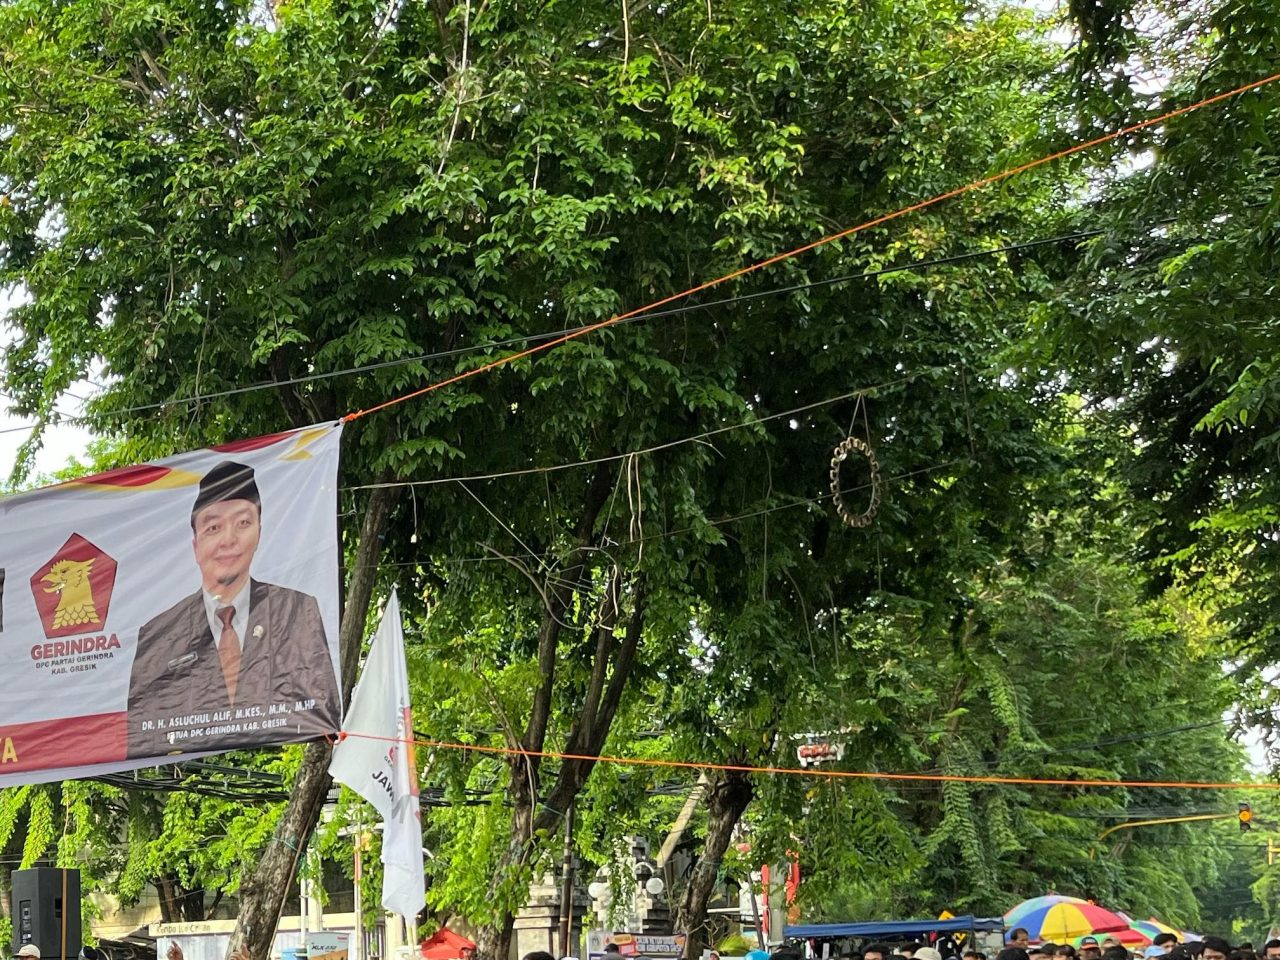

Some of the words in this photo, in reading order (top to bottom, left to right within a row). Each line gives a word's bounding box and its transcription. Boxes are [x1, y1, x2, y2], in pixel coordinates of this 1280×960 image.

[30, 633, 121, 660] GERINDRA
[51, 658, 75, 667] PARTAI
[76, 652, 114, 663] GERINDRA
[51, 667, 68, 675] KAB.
[69, 663, 97, 673] GRESIK
[141, 720, 156, 731] DR.
[157, 718, 167, 729] H.
[168, 713, 211, 727] ASLUCHUL
[212, 710, 234, 723] ALIF,
[190, 727, 204, 738] DPC
[205, 723, 242, 736] GERINDRA
[242, 720, 261, 731] KAB.
[262, 717, 288, 730] GRESIK
